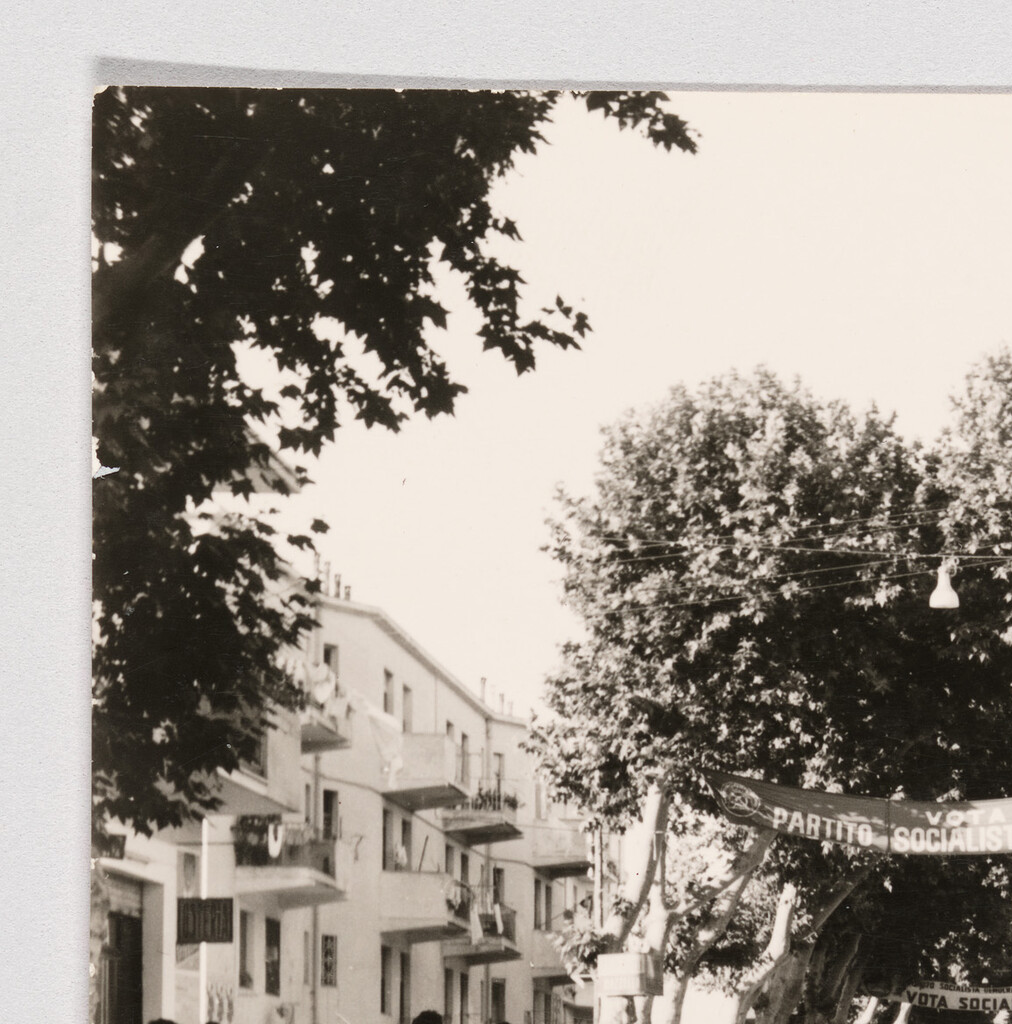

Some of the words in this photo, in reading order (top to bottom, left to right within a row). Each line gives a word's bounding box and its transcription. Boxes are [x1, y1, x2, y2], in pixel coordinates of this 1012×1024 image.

[772, 806, 873, 847] PARTITO
[925, 808, 1006, 826] VOTA
[906, 990, 949, 1009] VOTA
